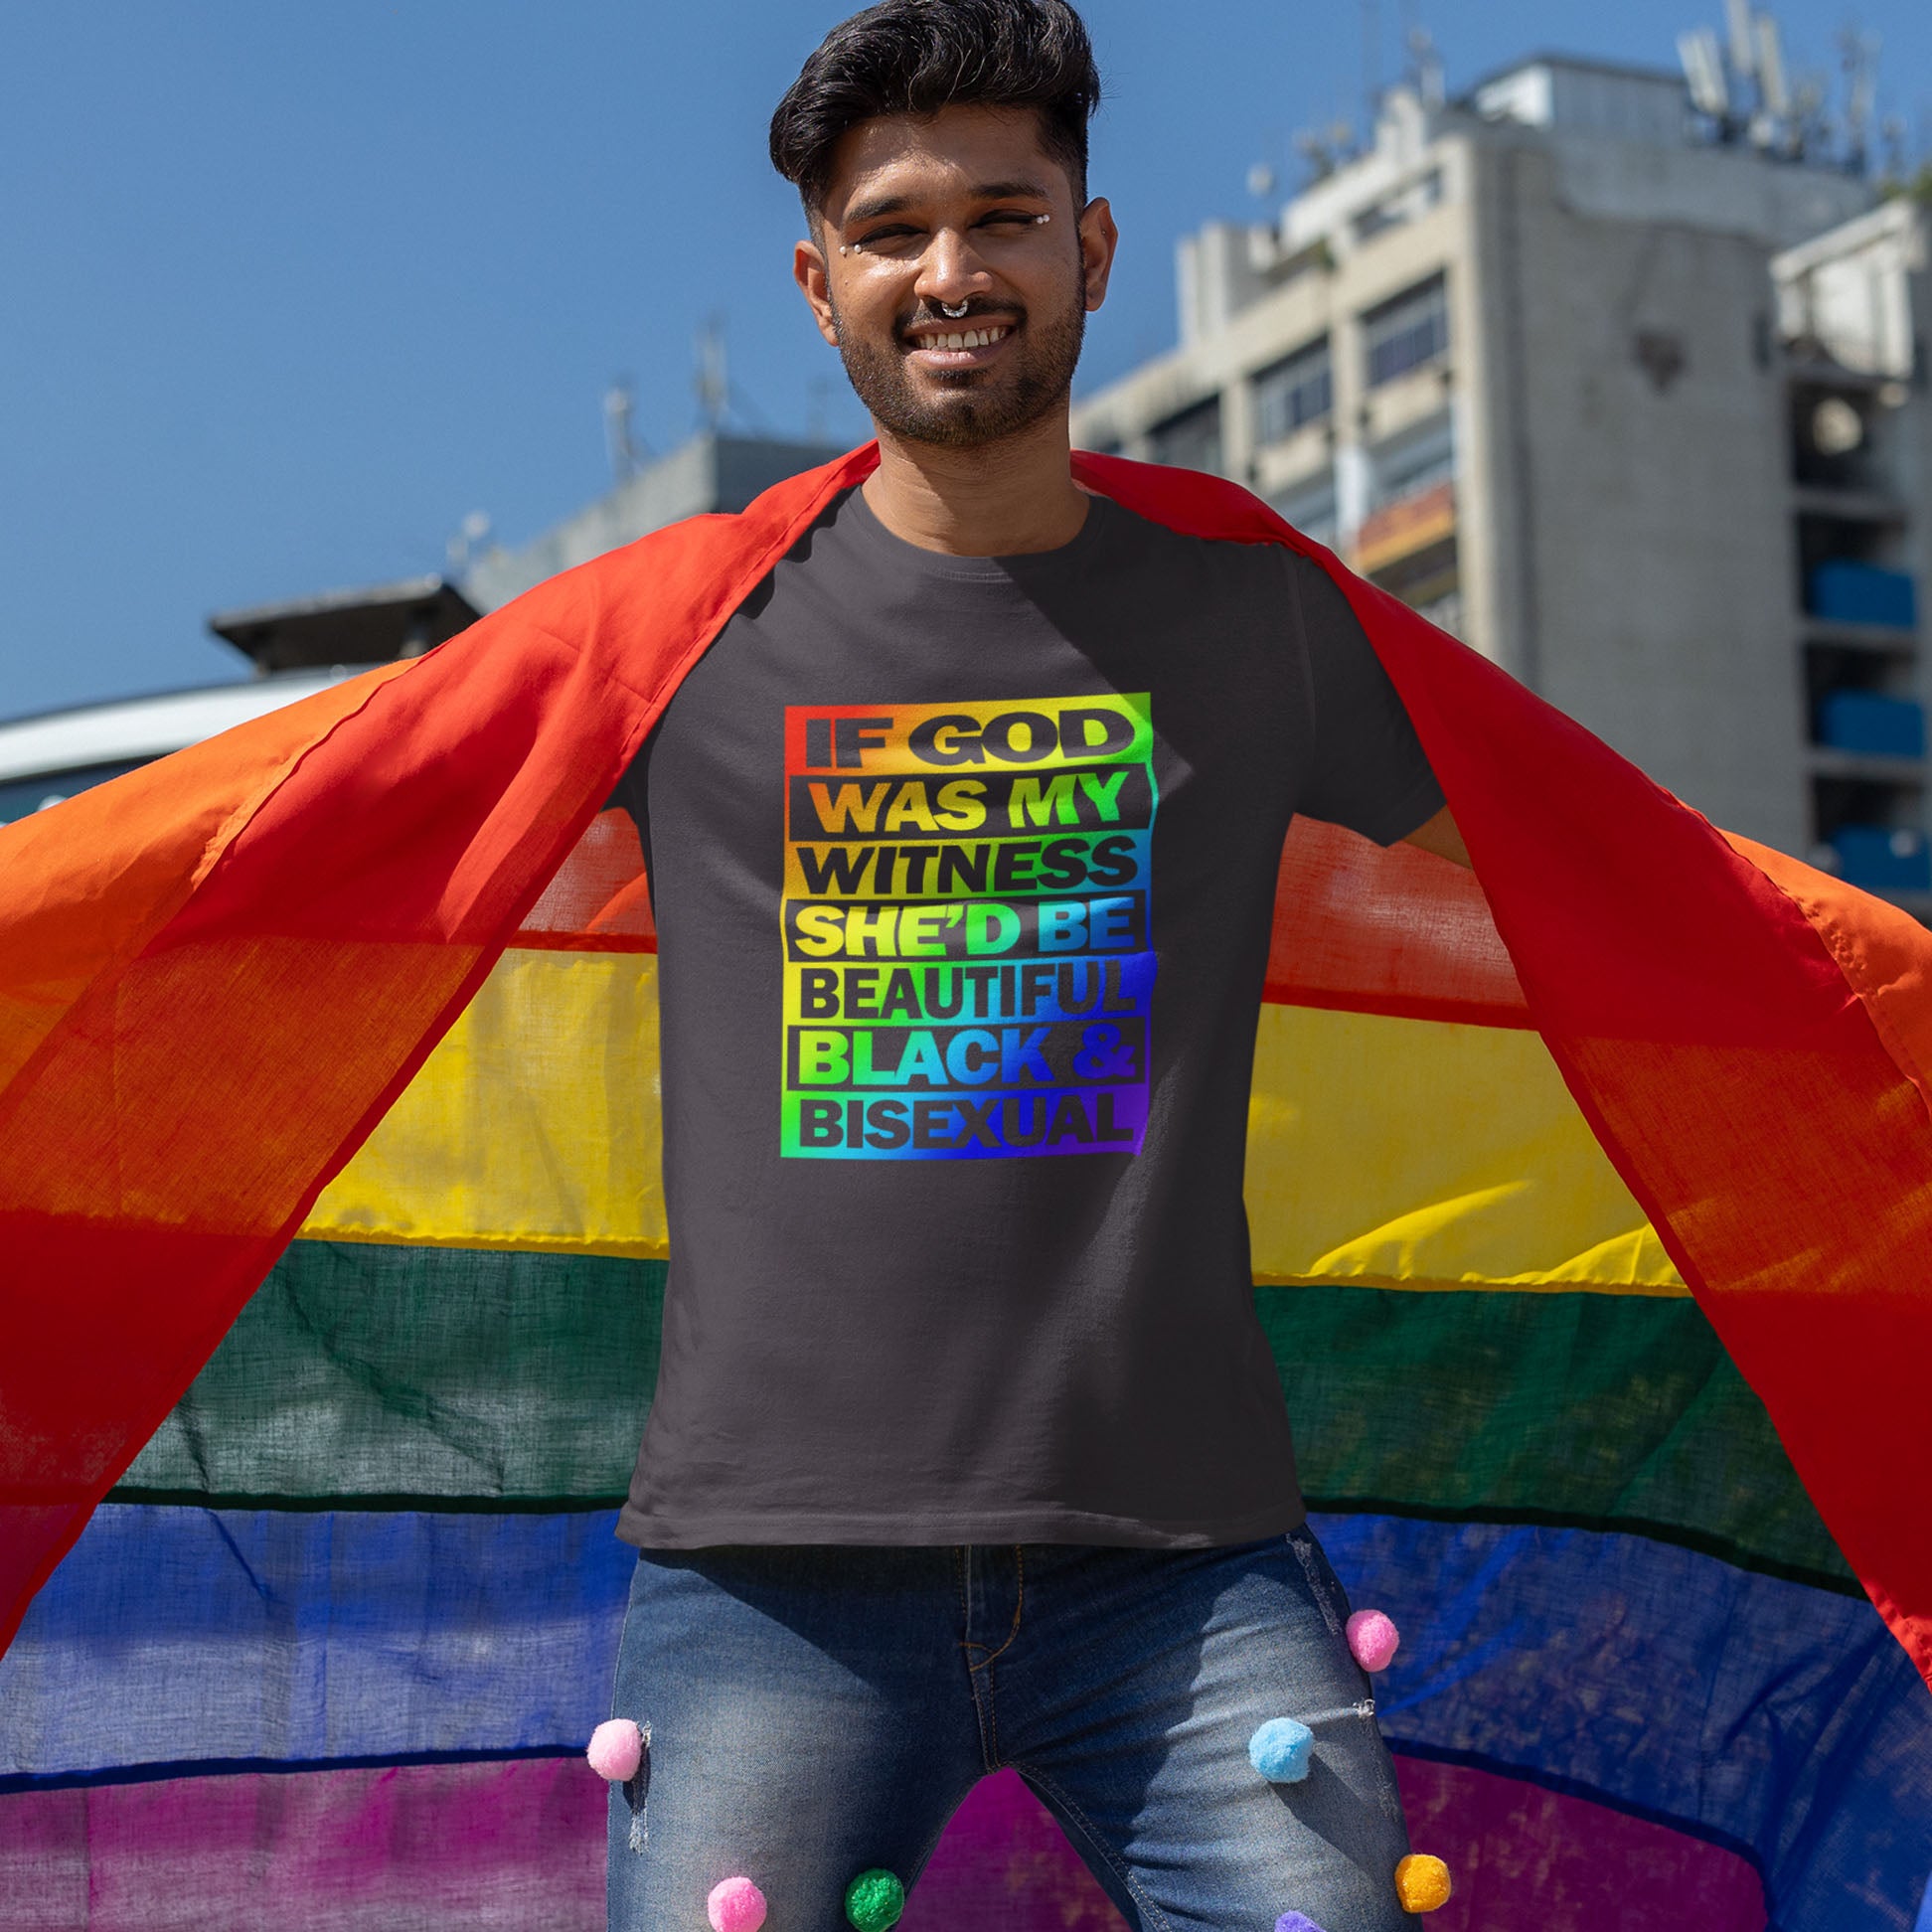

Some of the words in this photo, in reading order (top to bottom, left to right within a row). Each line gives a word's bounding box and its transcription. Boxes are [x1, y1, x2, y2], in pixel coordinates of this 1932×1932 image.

[805, 716, 893, 769] IF
[907, 709, 1135, 766] GOD
[808, 779, 988, 833] WAS
[1008, 770, 1130, 828] MY
[795, 836, 1138, 894] WITNESS
[794, 902, 1021, 957] SHE'D
[1039, 896, 1135, 952] BE
[800, 959, 1136, 1020] BEAUTIFUL
[798, 1027, 1054, 1085] BLACK
[1073, 1023, 1135, 1078] &
[799, 1093, 1134, 1149] BISEXUAL
